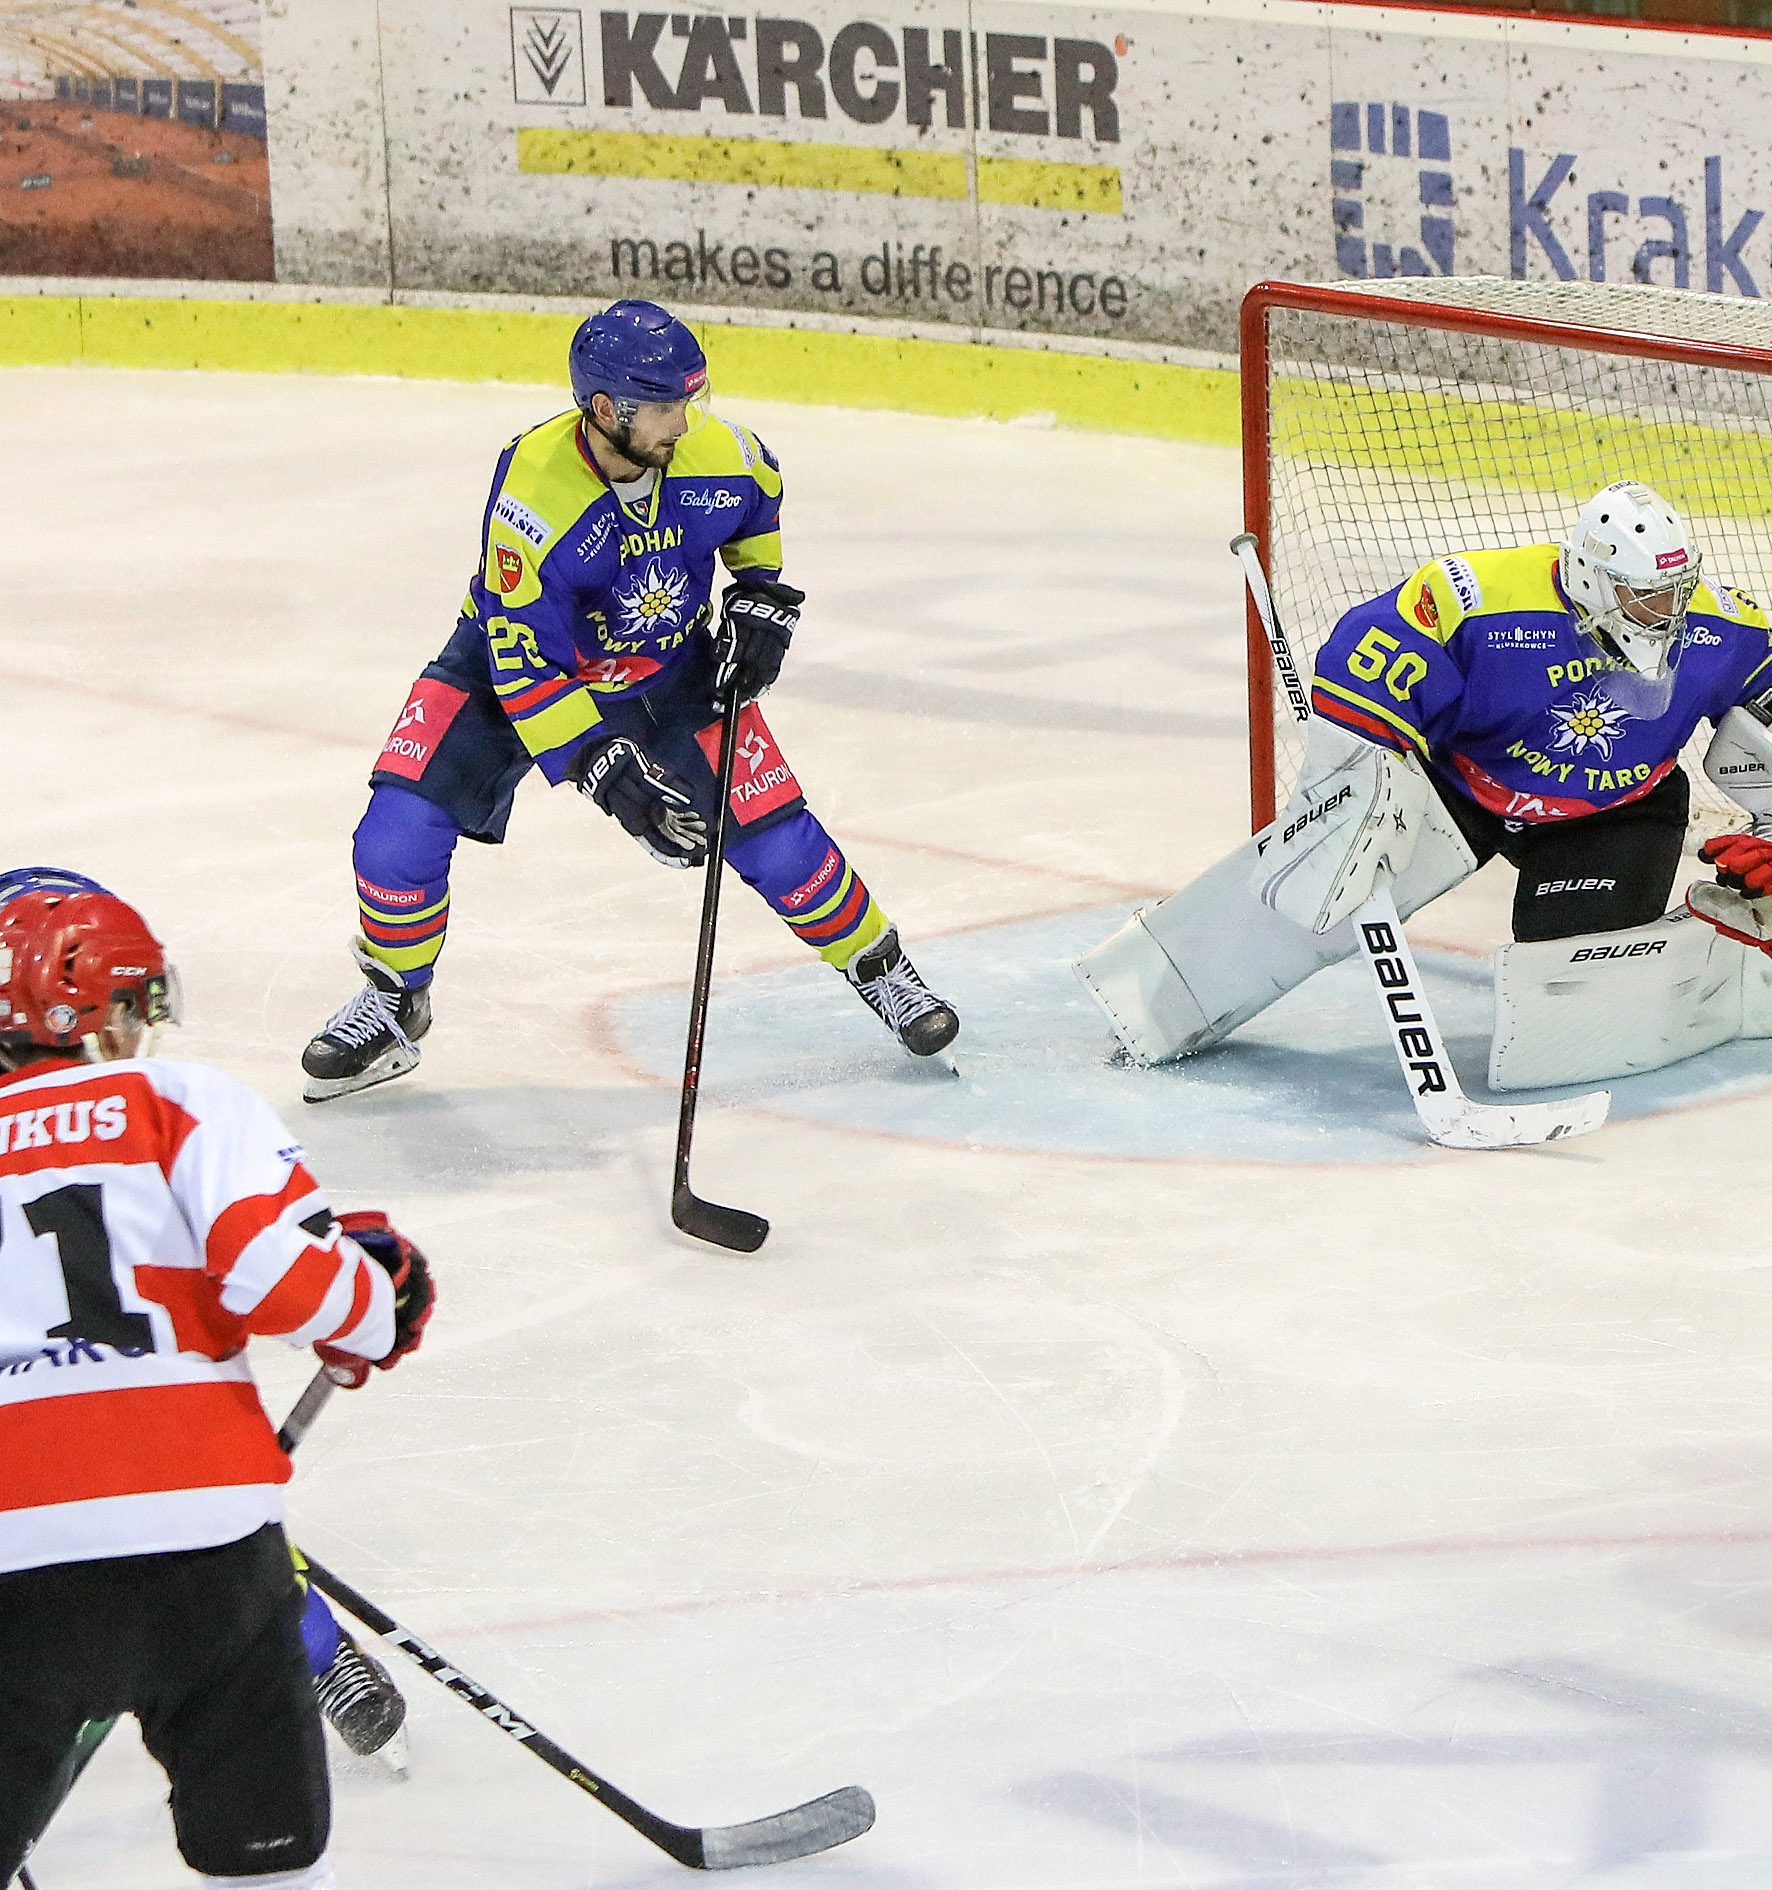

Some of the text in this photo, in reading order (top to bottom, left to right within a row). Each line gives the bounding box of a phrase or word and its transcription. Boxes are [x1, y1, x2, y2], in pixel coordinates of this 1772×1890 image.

[601, 11, 1121, 143] KÄRCHER
[611, 230, 793, 289] makes
[811, 250, 844, 293] a
[680, 489, 742, 515] BabyBoo
[586, 610, 646, 653] NOWY
[1487, 630, 1556, 641] STYL CHYN
[1271, 639, 1312, 723] BAUER
[1346, 625, 1429, 702] 50
[730, 763, 793, 804] TAURON
[1506, 739, 1652, 792] NOWY TARG
[1719, 763, 1766, 775] BAUER
[1283, 784, 1353, 844] BAUER
[367, 886, 418, 903] TAURON
[804, 855, 836, 894] TAURON
[1535, 878, 1617, 897] BAUER
[110, 966, 148, 977] CCM
[1569, 940, 1668, 963] BAUER
[1360, 921, 1447, 1097] BAUER
[381, 1627, 539, 1741] CCM
